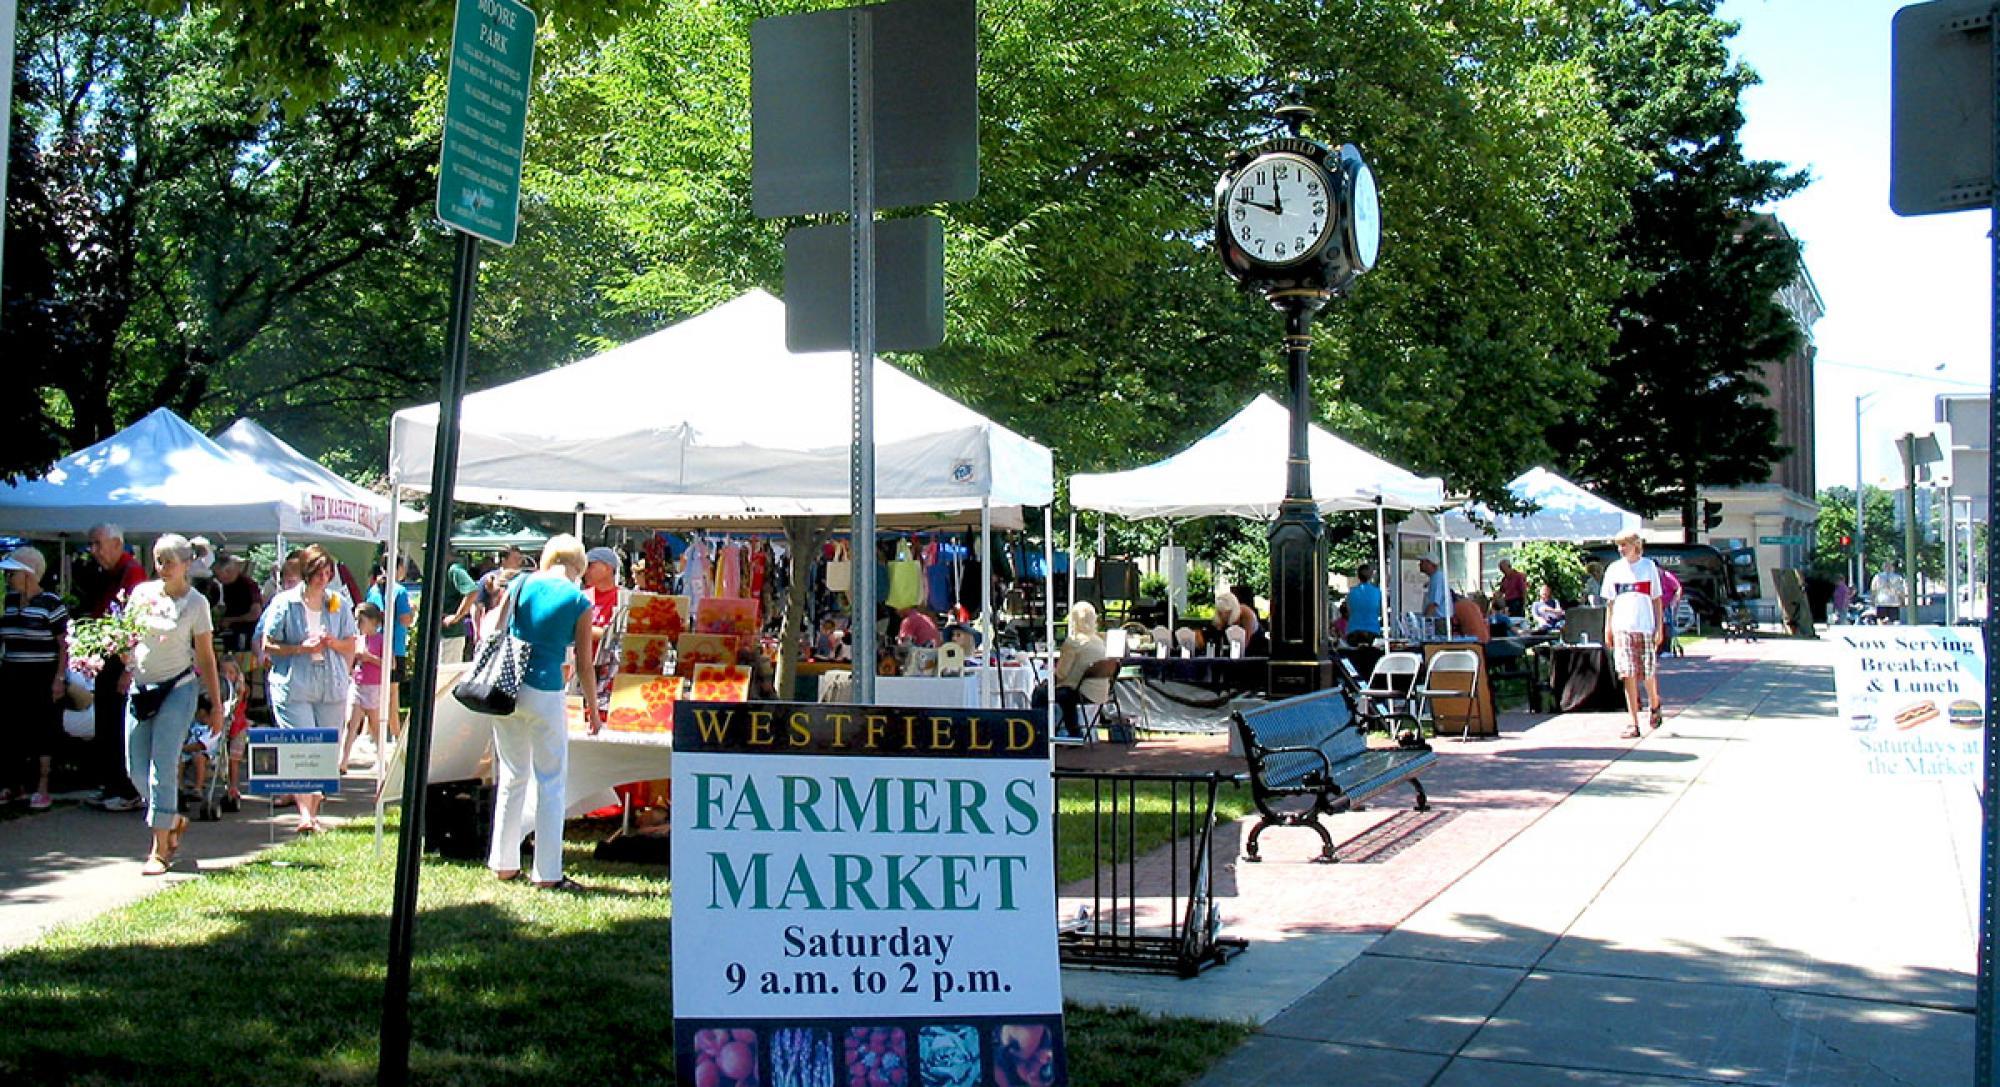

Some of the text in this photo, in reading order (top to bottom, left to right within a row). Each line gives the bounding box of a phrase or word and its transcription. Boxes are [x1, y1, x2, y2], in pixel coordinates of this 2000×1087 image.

[478, 0, 517, 31] MOORE
[479, 23, 509, 55] PARK
[1257, 171, 1266, 186] 11
[1297, 168, 1302, 183] 1
[1307, 181, 1319, 197] 2
[1313, 200, 1324, 216] 3
[1241, 226, 1251, 240] 8
[1308, 222, 1318, 237] 4
[1255, 238, 1265, 253] 7
[1274, 242, 1286, 258] 6
[1843, 635, 1975, 655] Now Serving
[1861, 657, 1961, 673] Breakfast
[1866, 678, 1960, 693] & Lunch
[694, 709, 1036, 752] WESTFIELD
[1859, 735, 1981, 755] Saturdays at
[1867, 755, 1977, 776] the Market
[690, 773, 1040, 836] FARMERS
[706, 851, 1028, 912] MARKET
[784, 925, 954, 965] Saturday
[726, 961, 1012, 1002] 9 a.m. to 2 p.m.
